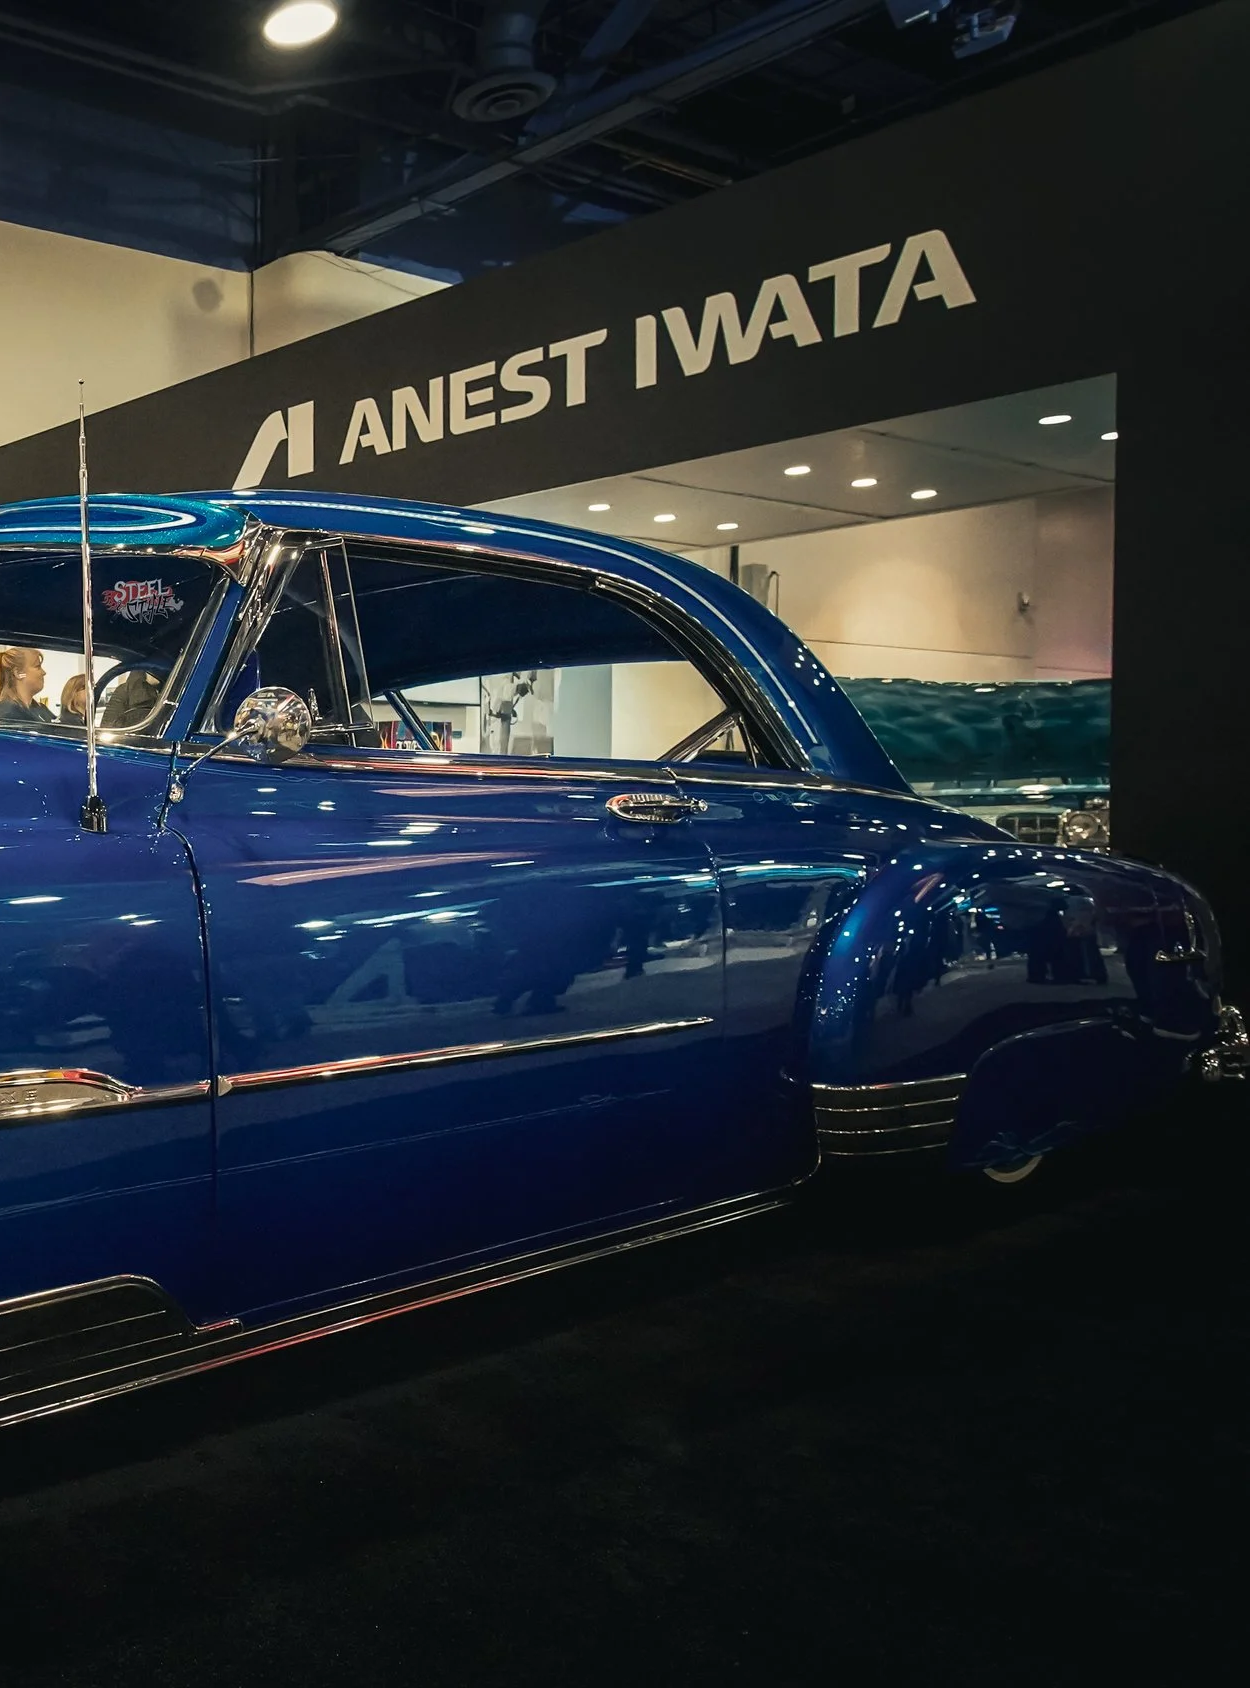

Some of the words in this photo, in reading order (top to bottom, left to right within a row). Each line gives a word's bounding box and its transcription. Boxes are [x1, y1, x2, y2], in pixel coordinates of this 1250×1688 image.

[339, 329, 608, 465] ANEST
[636, 229, 977, 390] IWATA
[114, 578, 170, 602] STEEL
